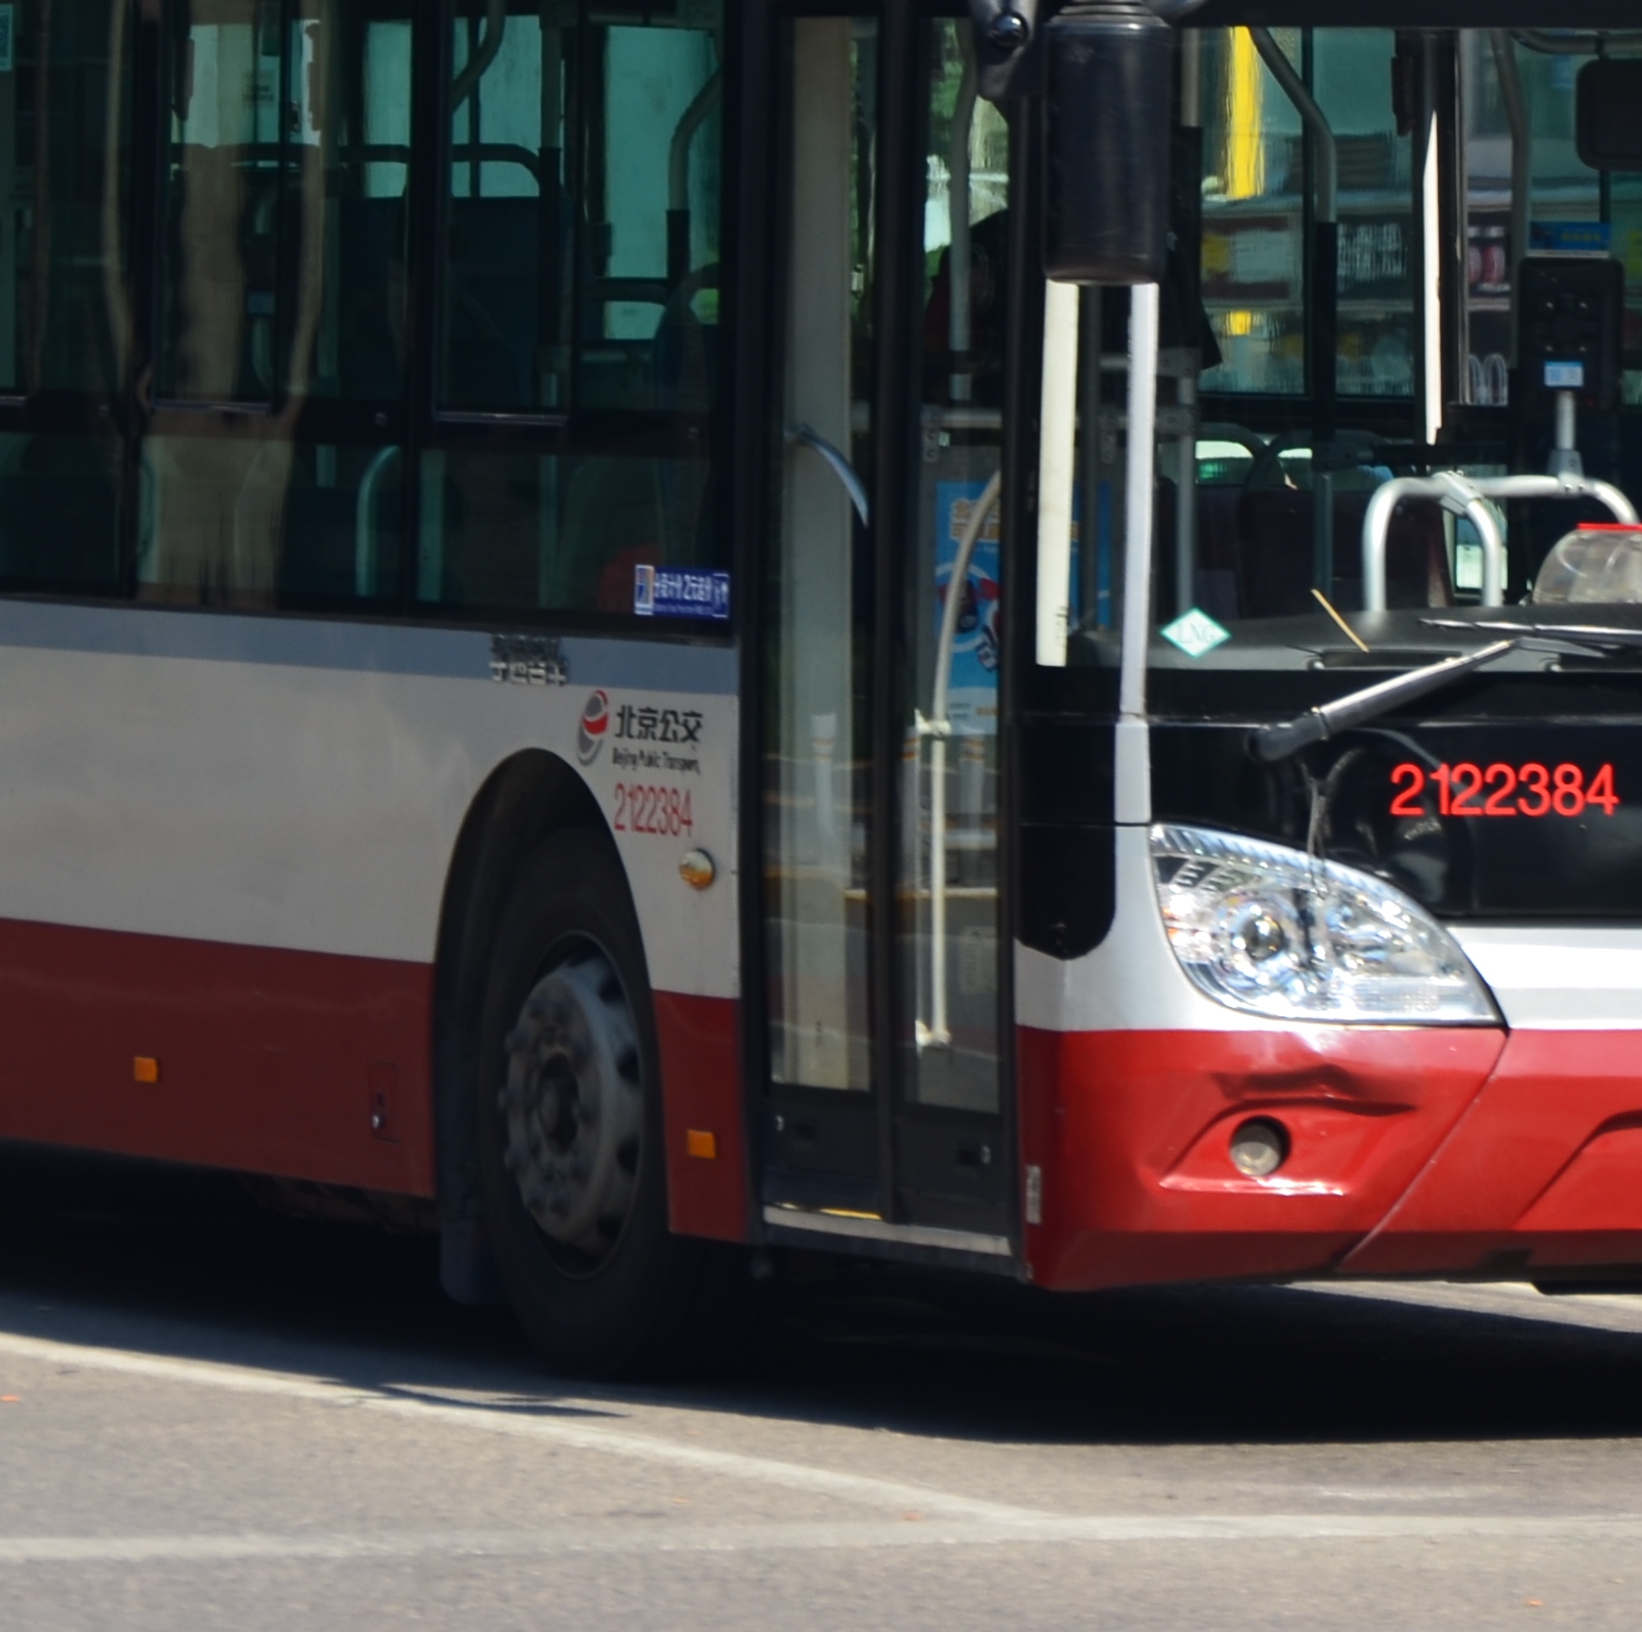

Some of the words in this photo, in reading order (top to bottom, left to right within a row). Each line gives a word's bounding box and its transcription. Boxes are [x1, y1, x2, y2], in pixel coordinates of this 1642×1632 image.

[614, 704, 703, 744] 北京公交
[614, 783, 693, 837] 2122384
[1389, 764, 1619, 816] 2122384
